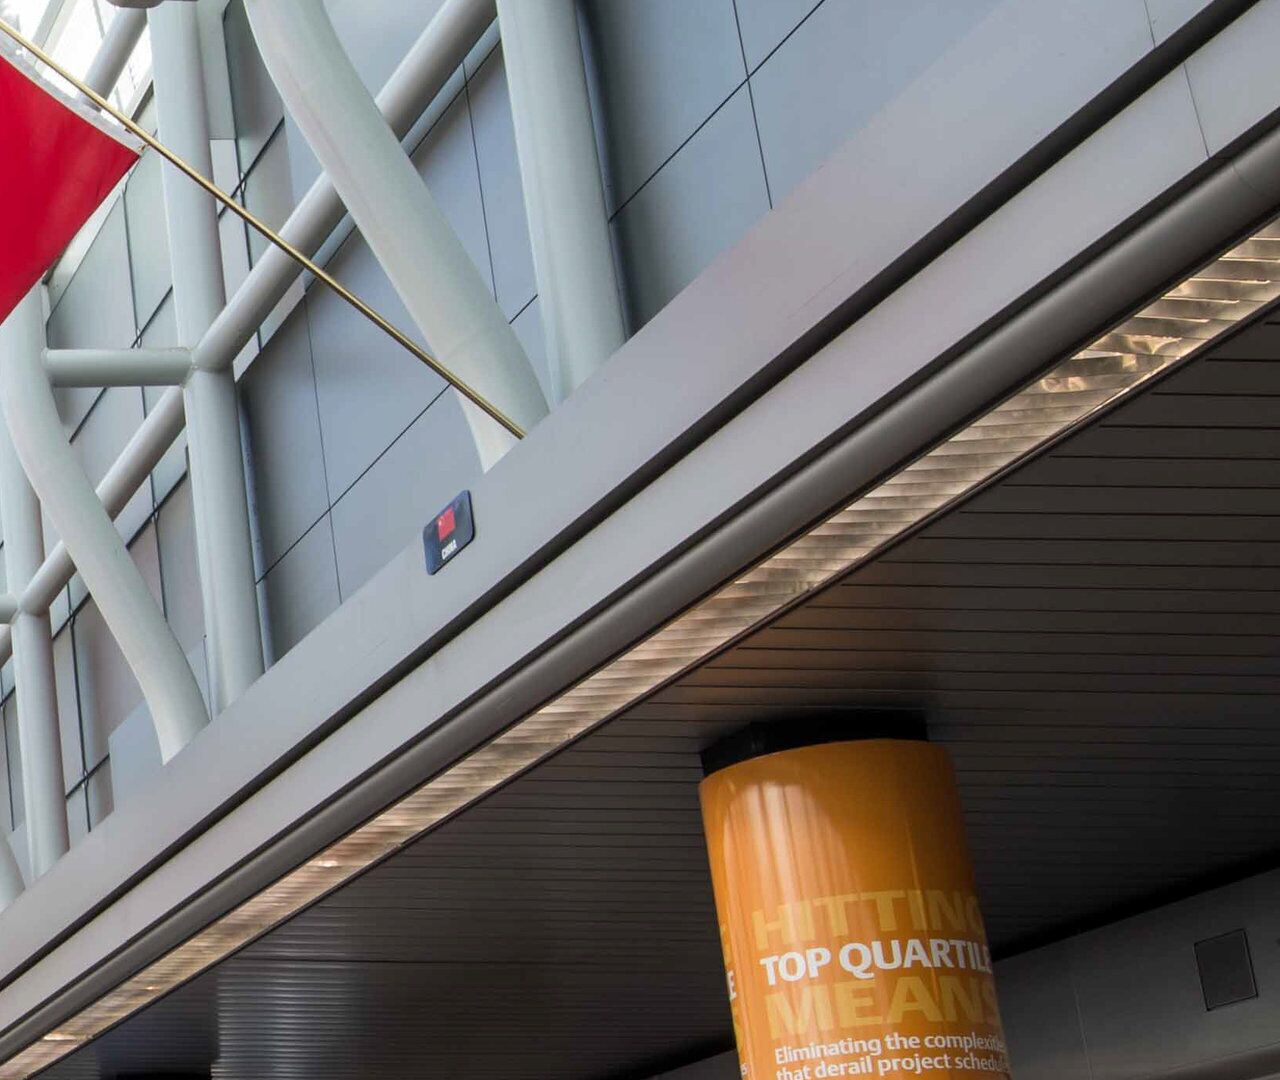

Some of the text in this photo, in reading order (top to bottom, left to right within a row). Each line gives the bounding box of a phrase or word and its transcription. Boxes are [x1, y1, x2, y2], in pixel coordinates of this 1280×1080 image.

[759, 947, 831, 986] TOP
[775, 1037, 882, 1065] Eliminating
[884, 1032, 920, 1050] the
[815, 1056, 873, 1079] derail
[877, 1053, 952, 1077] project
